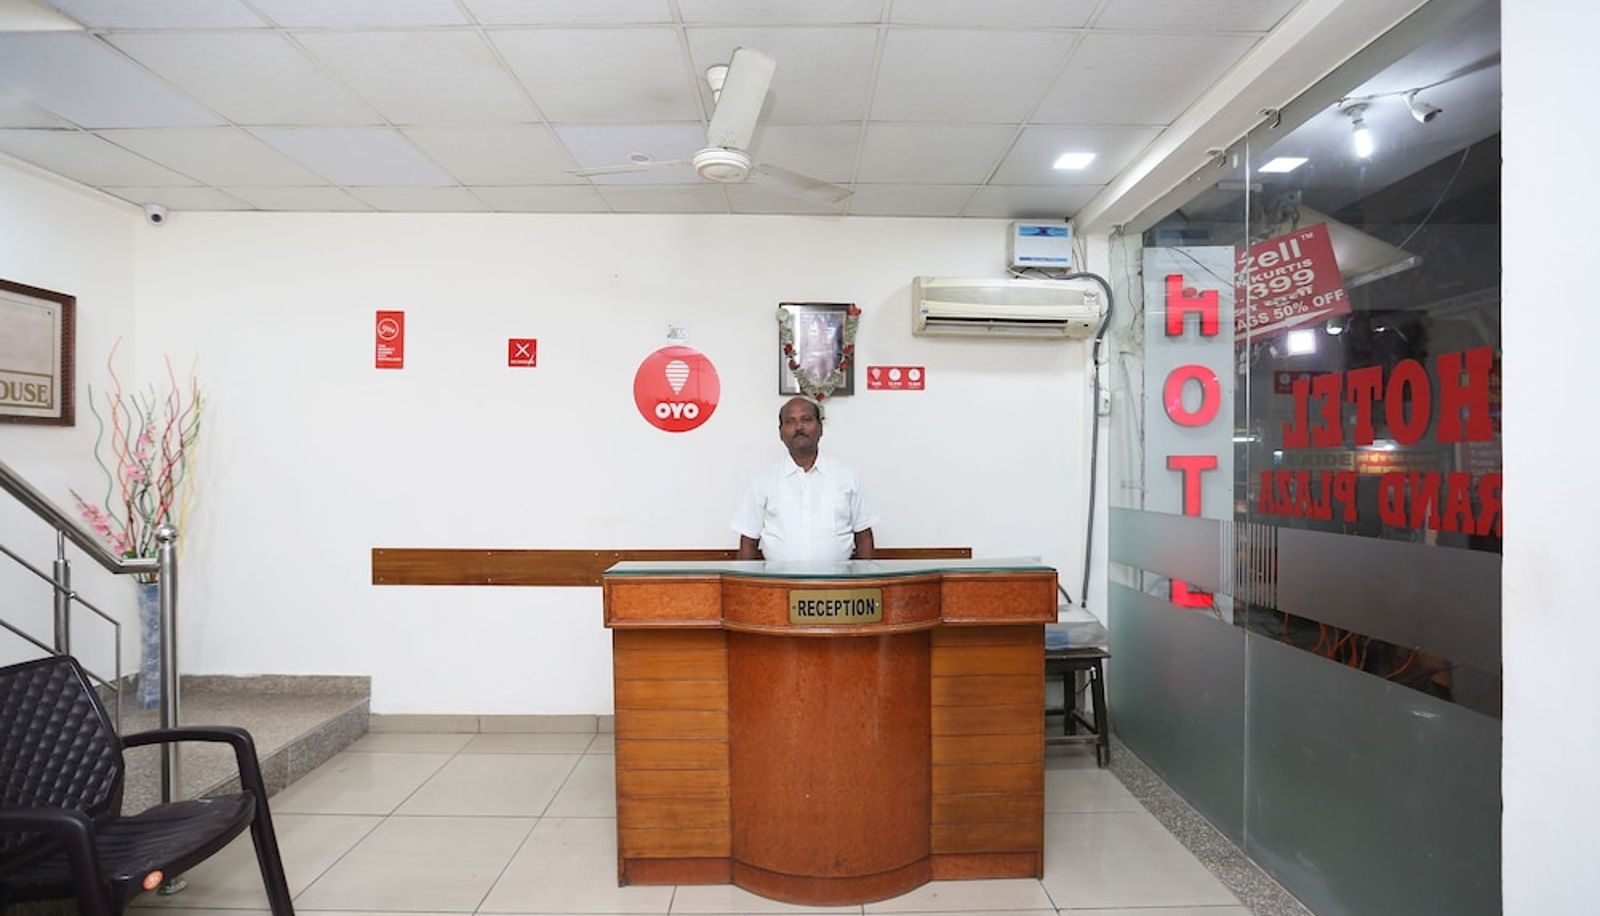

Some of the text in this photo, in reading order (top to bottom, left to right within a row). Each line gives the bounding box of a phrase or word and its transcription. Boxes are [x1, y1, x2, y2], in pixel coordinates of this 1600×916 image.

[1250, 259, 1313, 283] KURTIS
[1274, 301, 1309, 319] 50%
[1312, 289, 1344, 307] OFF
[655, 402, 699, 419] OYO
[798, 599, 875, 616] RECEPTION
